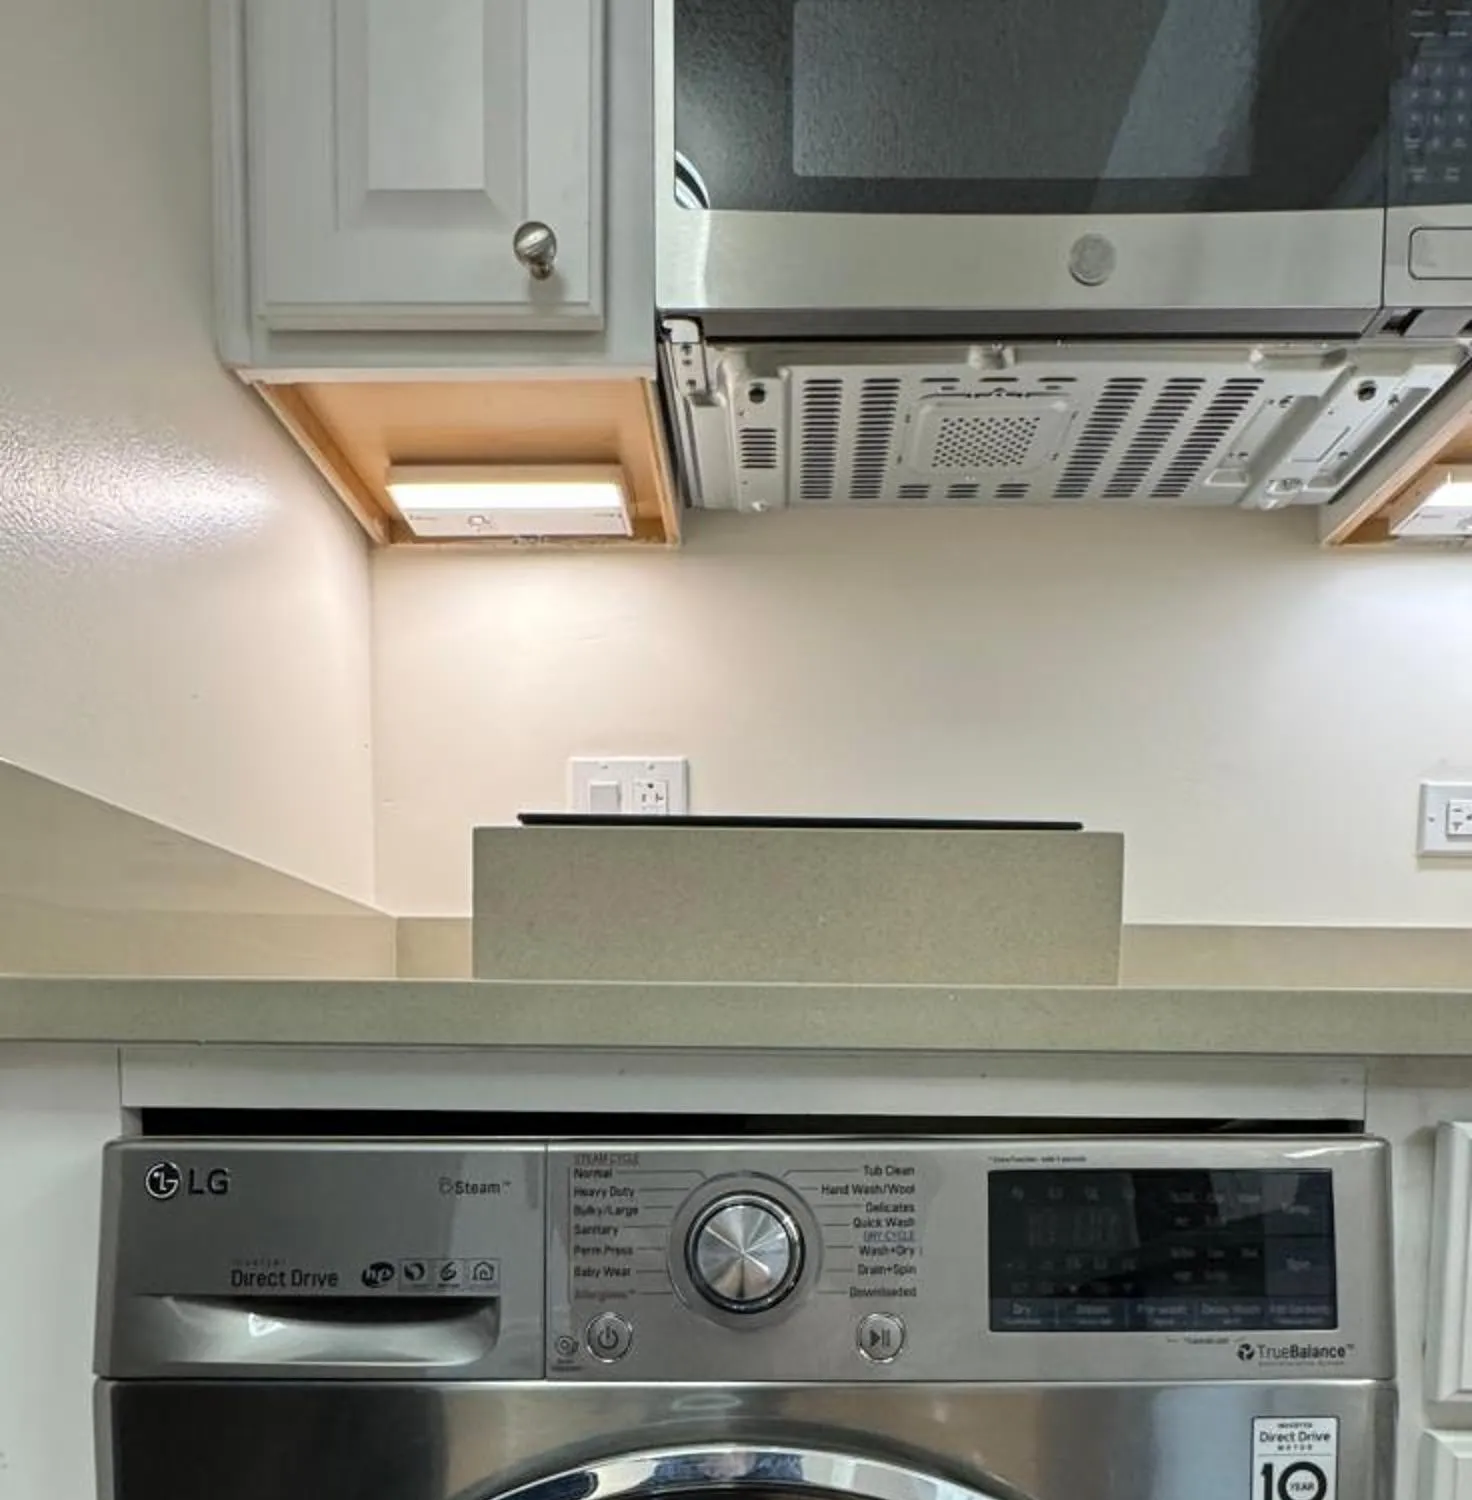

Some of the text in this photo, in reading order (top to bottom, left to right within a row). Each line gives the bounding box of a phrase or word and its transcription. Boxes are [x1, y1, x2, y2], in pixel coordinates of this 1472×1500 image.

[574, 1168, 612, 1178] Normal
[864, 1165, 915, 1176] Tub Clean
[188, 1167, 229, 1195] LG
[574, 1186, 634, 1200] Heavy Duty
[821, 1183, 915, 1195] Hand Wash/Wool
[574, 1205, 639, 1217] Bulky/Large
[865, 1201, 915, 1213] Delicates
[853, 1217, 915, 1229] Quick Wash
[574, 1223, 619, 1237] Sanitary
[604, 1244, 634, 1256] Press
[859, 1245, 915, 1259] Wash+Dry
[574, 1266, 631, 1279] Baby Wear
[857, 1263, 917, 1276] Drain+Spin
[230, 1268, 287, 1288] Direct
[291, 1268, 339, 1288] Drive
[849, 1286, 917, 1298] Downloaded
[1259, 1431, 1331, 1442] Direct Drive
[1289, 1482, 1315, 1491] YEAR
